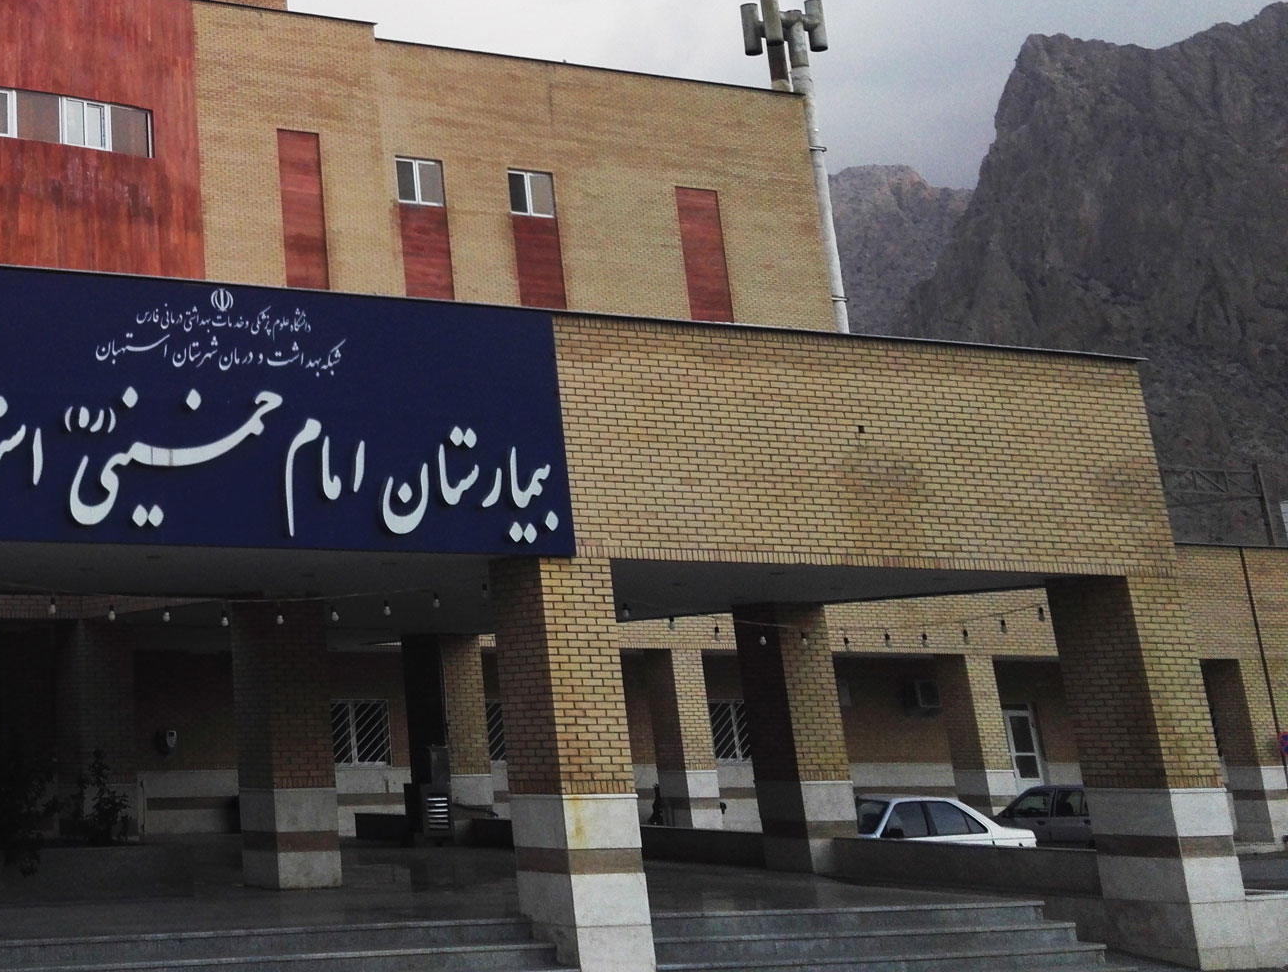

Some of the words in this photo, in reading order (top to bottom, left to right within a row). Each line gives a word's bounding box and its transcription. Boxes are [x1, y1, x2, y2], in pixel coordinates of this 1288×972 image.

[136, 308, 160, 324] فارس
[160, 303, 183, 330] درمانی
[183, 305, 212, 333] بهداشتی
[250, 305, 272, 336] پزشکی
[272, 316, 290, 341] علوم
[290, 308, 311, 333] دانشگاه
[95, 332, 171, 365] استهبان
[172, 335, 219, 368] شهرستان
[218, 346, 254, 371] درمان
[257, 352, 264, 365] و
[266, 341, 322, 377] بهداشت
[320, 337, 347, 376] شبکه
[68, 385, 284, 527] خمینی
[285, 418, 366, 538] امام
[382, 426, 560, 544] بیمارستان
